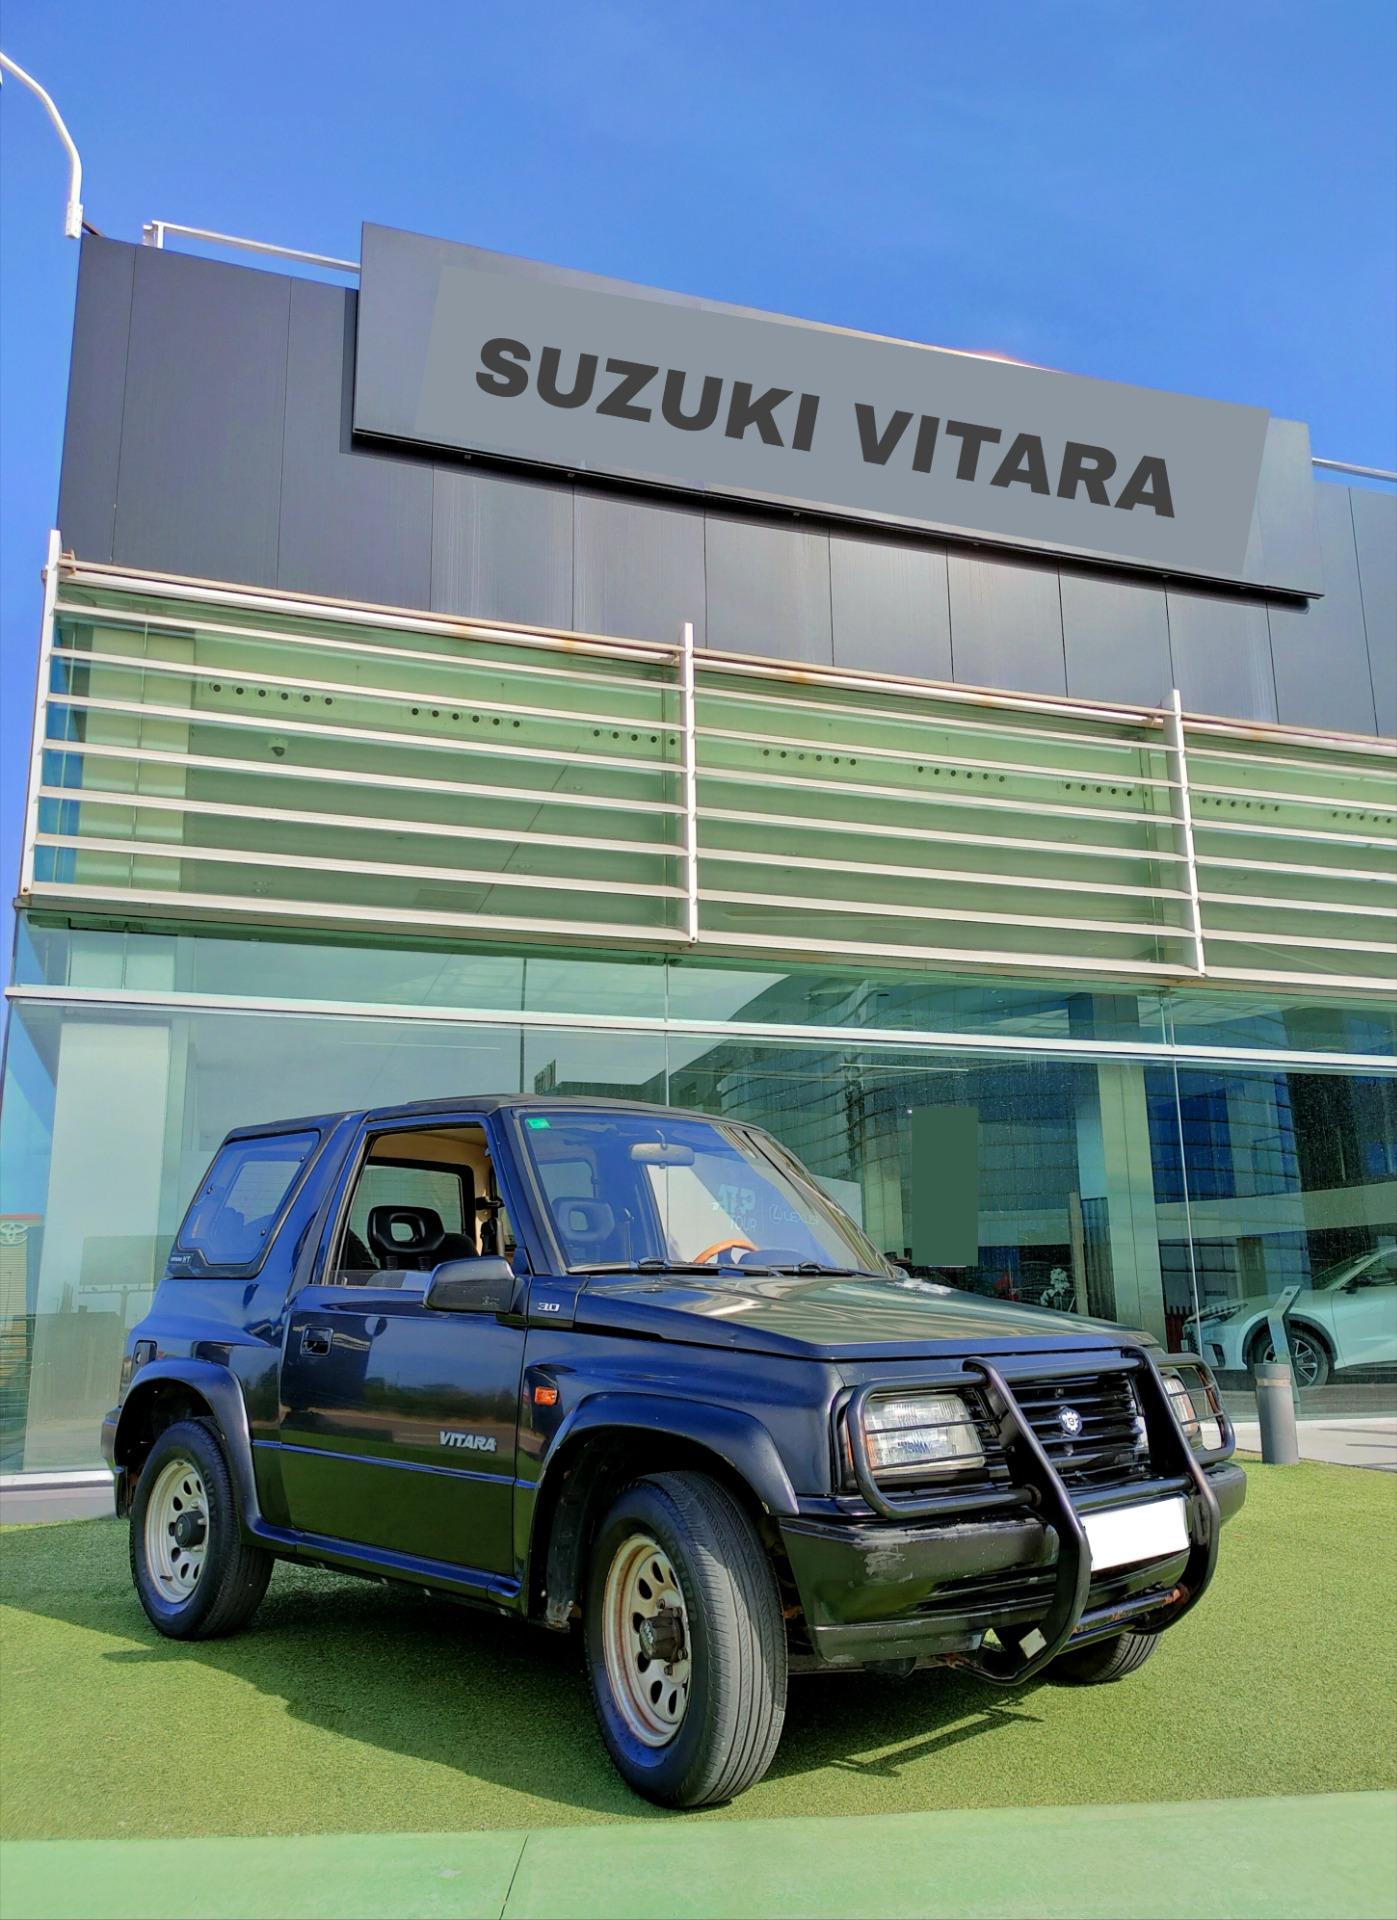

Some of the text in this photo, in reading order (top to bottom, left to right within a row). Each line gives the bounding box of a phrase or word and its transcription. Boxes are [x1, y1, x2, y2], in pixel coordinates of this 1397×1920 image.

[476, 338, 1175, 519] SUZUKI VITARA
[439, 1431, 496, 1452] VITARA
